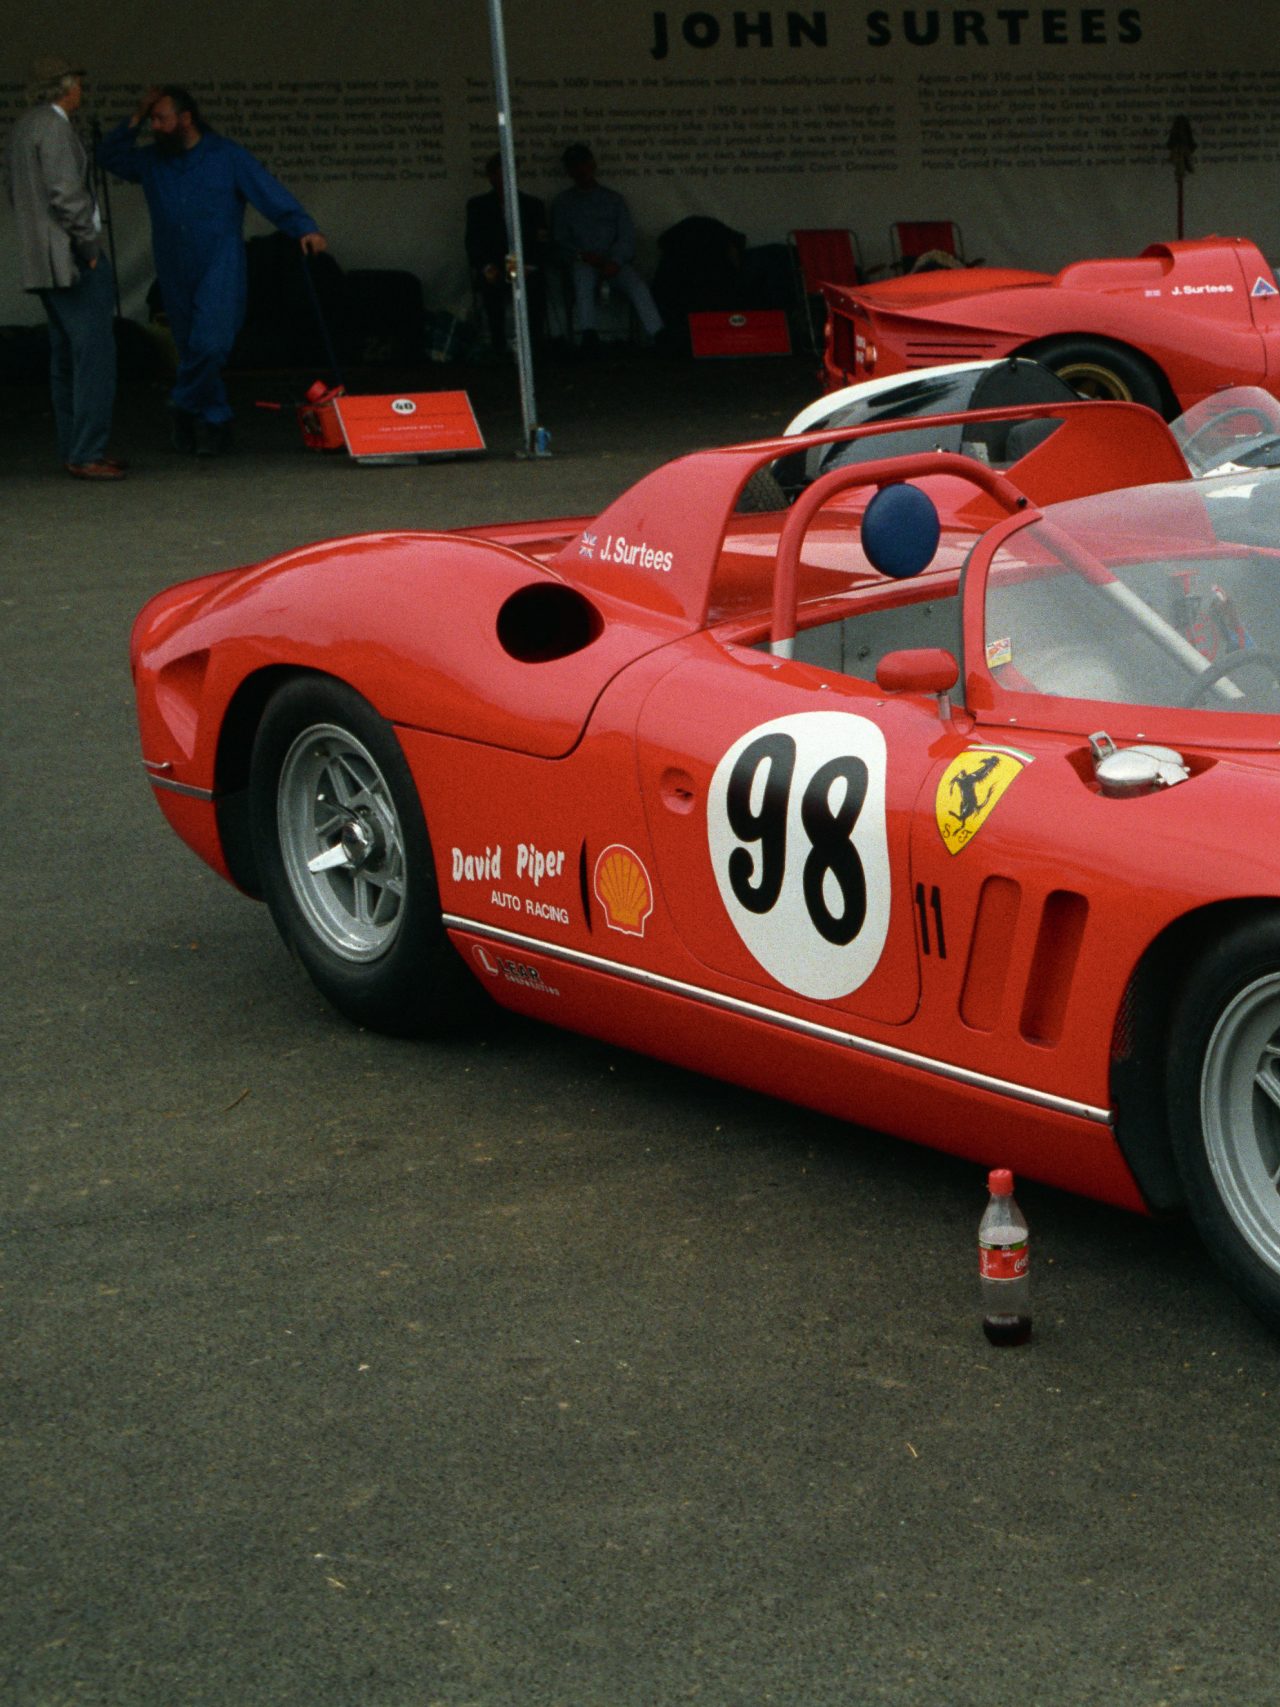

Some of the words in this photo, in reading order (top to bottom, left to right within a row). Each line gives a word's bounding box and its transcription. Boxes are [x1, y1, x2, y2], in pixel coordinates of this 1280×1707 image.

[653, 10, 828, 60] JOHN
[867, 8, 1143, 47] SURTEES
[600, 535, 673, 572] J.Surtees
[727, 733, 869, 947] 98
[452, 844, 502, 882] David
[516, 843, 565, 888] Piper
[491, 890, 522, 912] AUTO
[525, 899, 569, 925] RACING
[915, 883, 947, 960] 11
